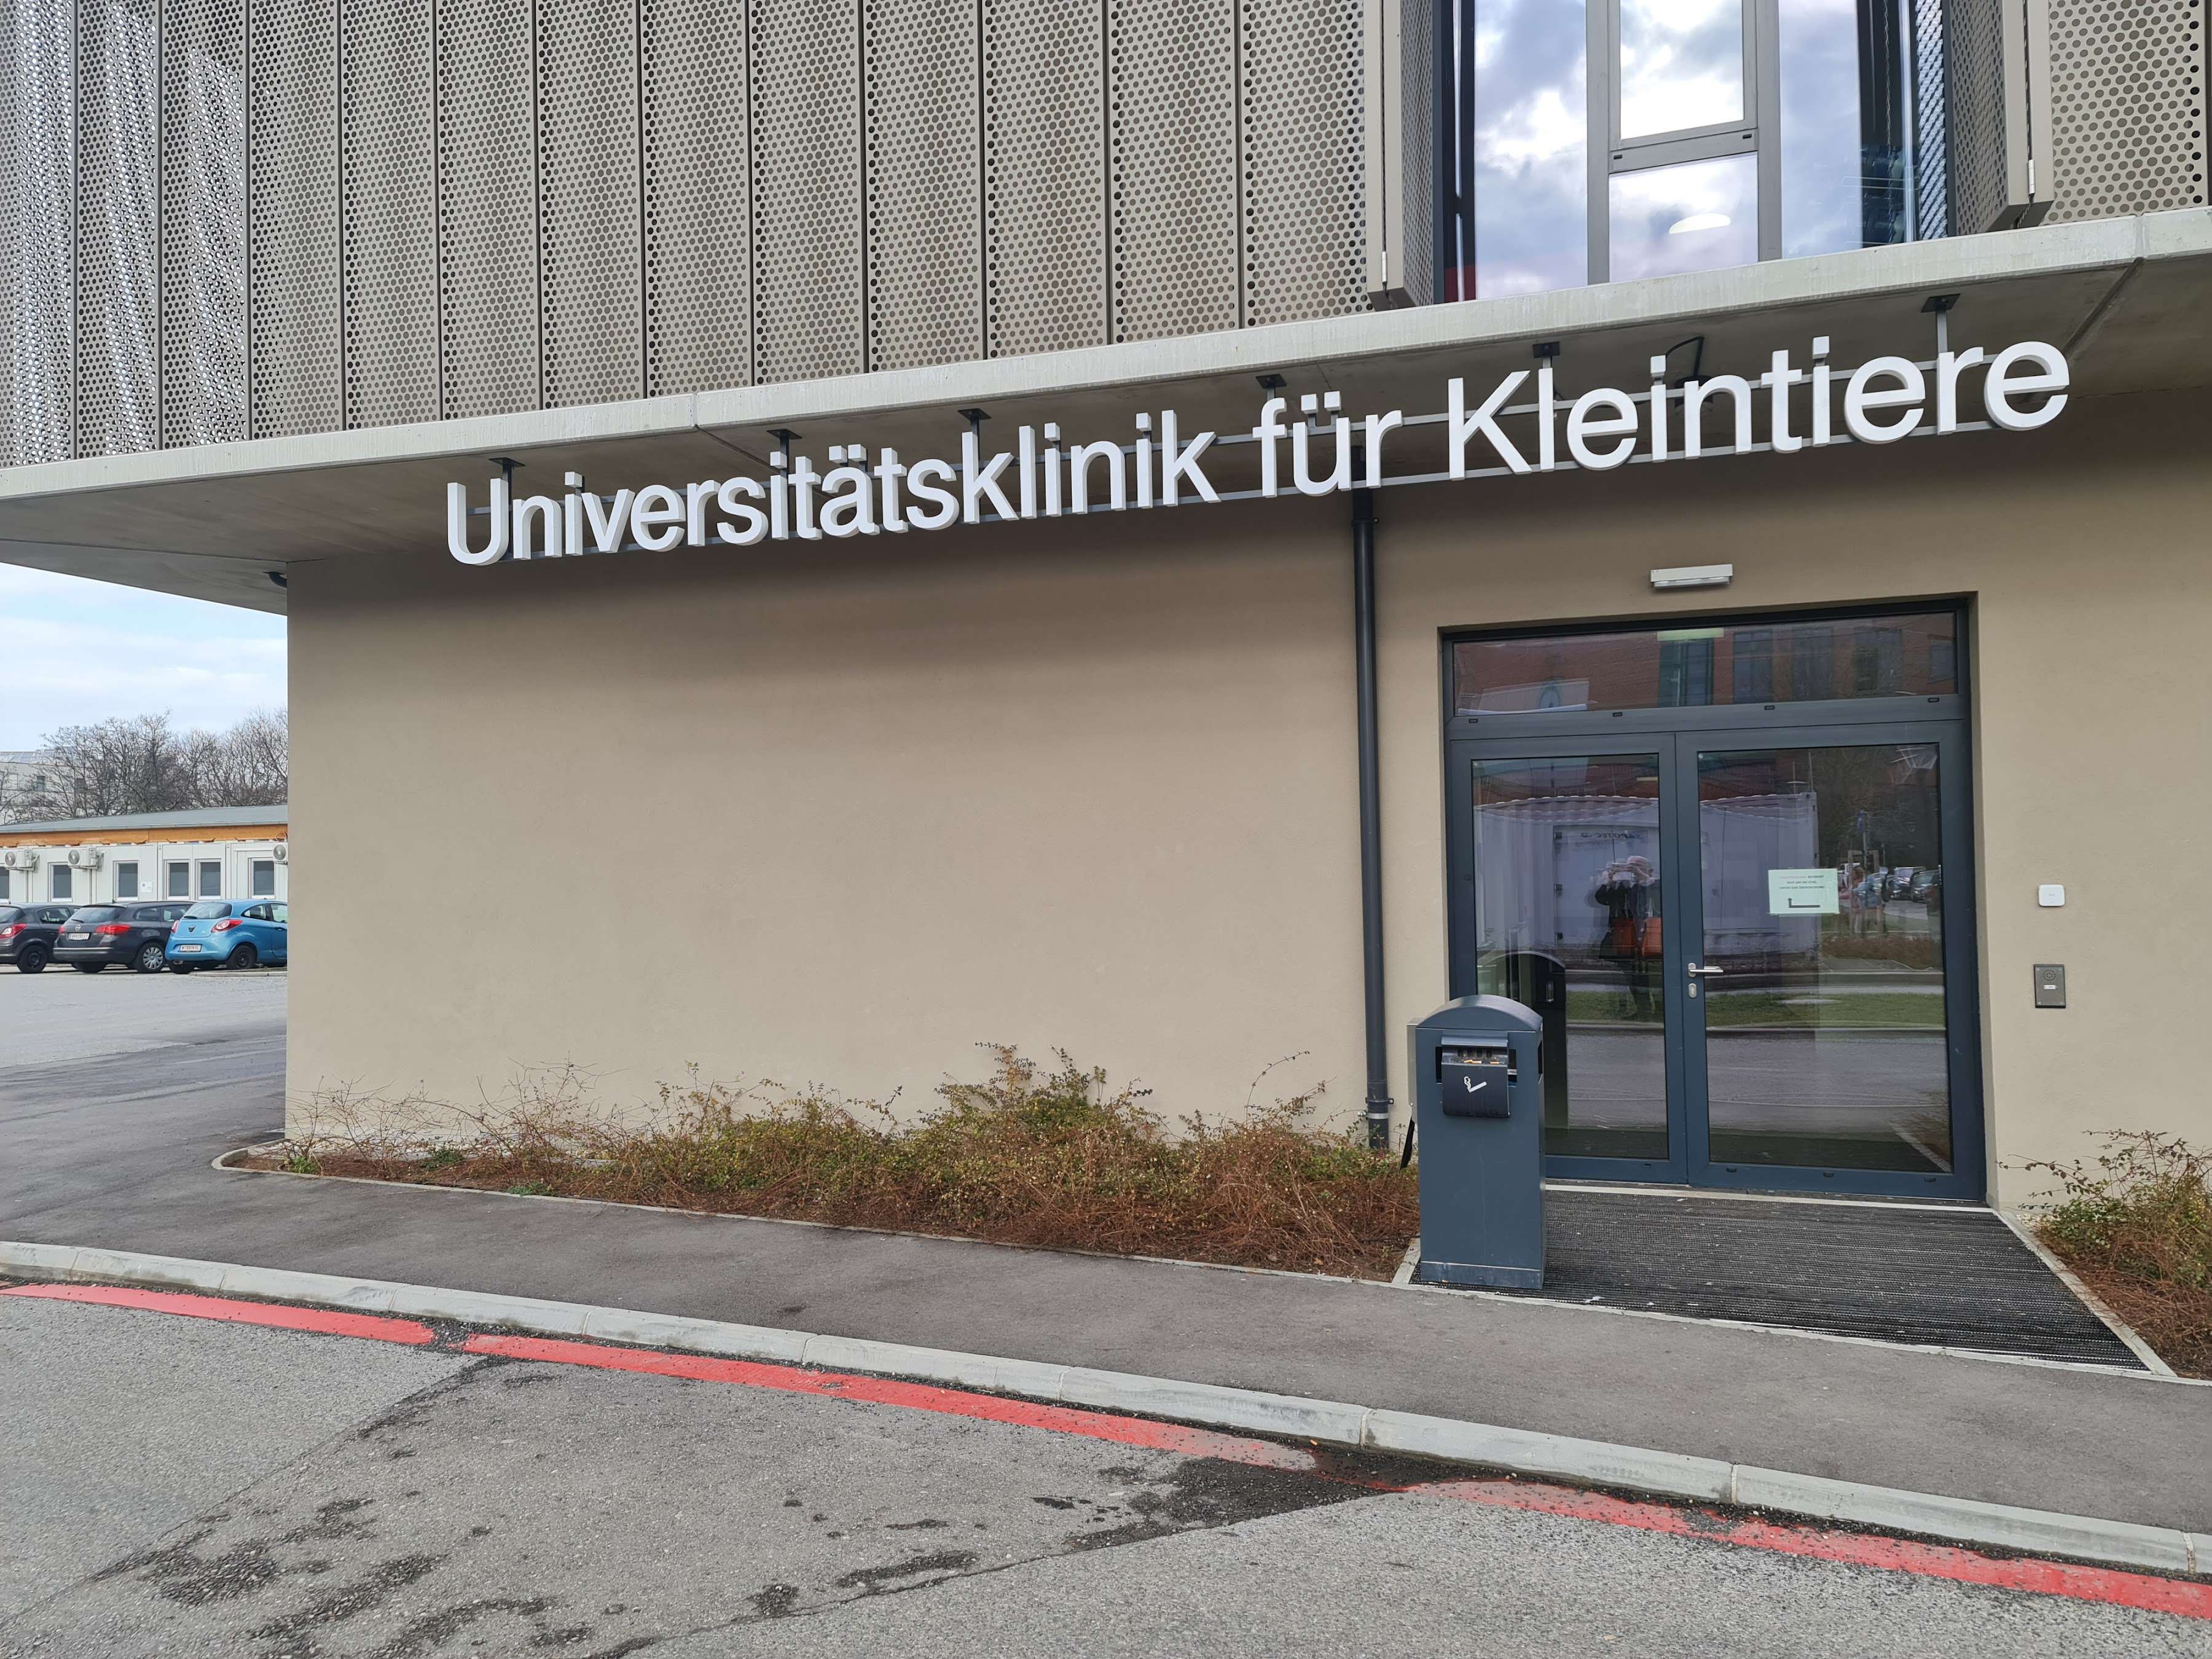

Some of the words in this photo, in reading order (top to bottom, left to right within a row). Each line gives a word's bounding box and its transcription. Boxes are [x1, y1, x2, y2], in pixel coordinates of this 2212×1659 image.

[447, 409, 1221, 566] Universitätsklinik
[1252, 391, 1402, 497] für
[1448, 335, 2070, 480] Kleintiere
